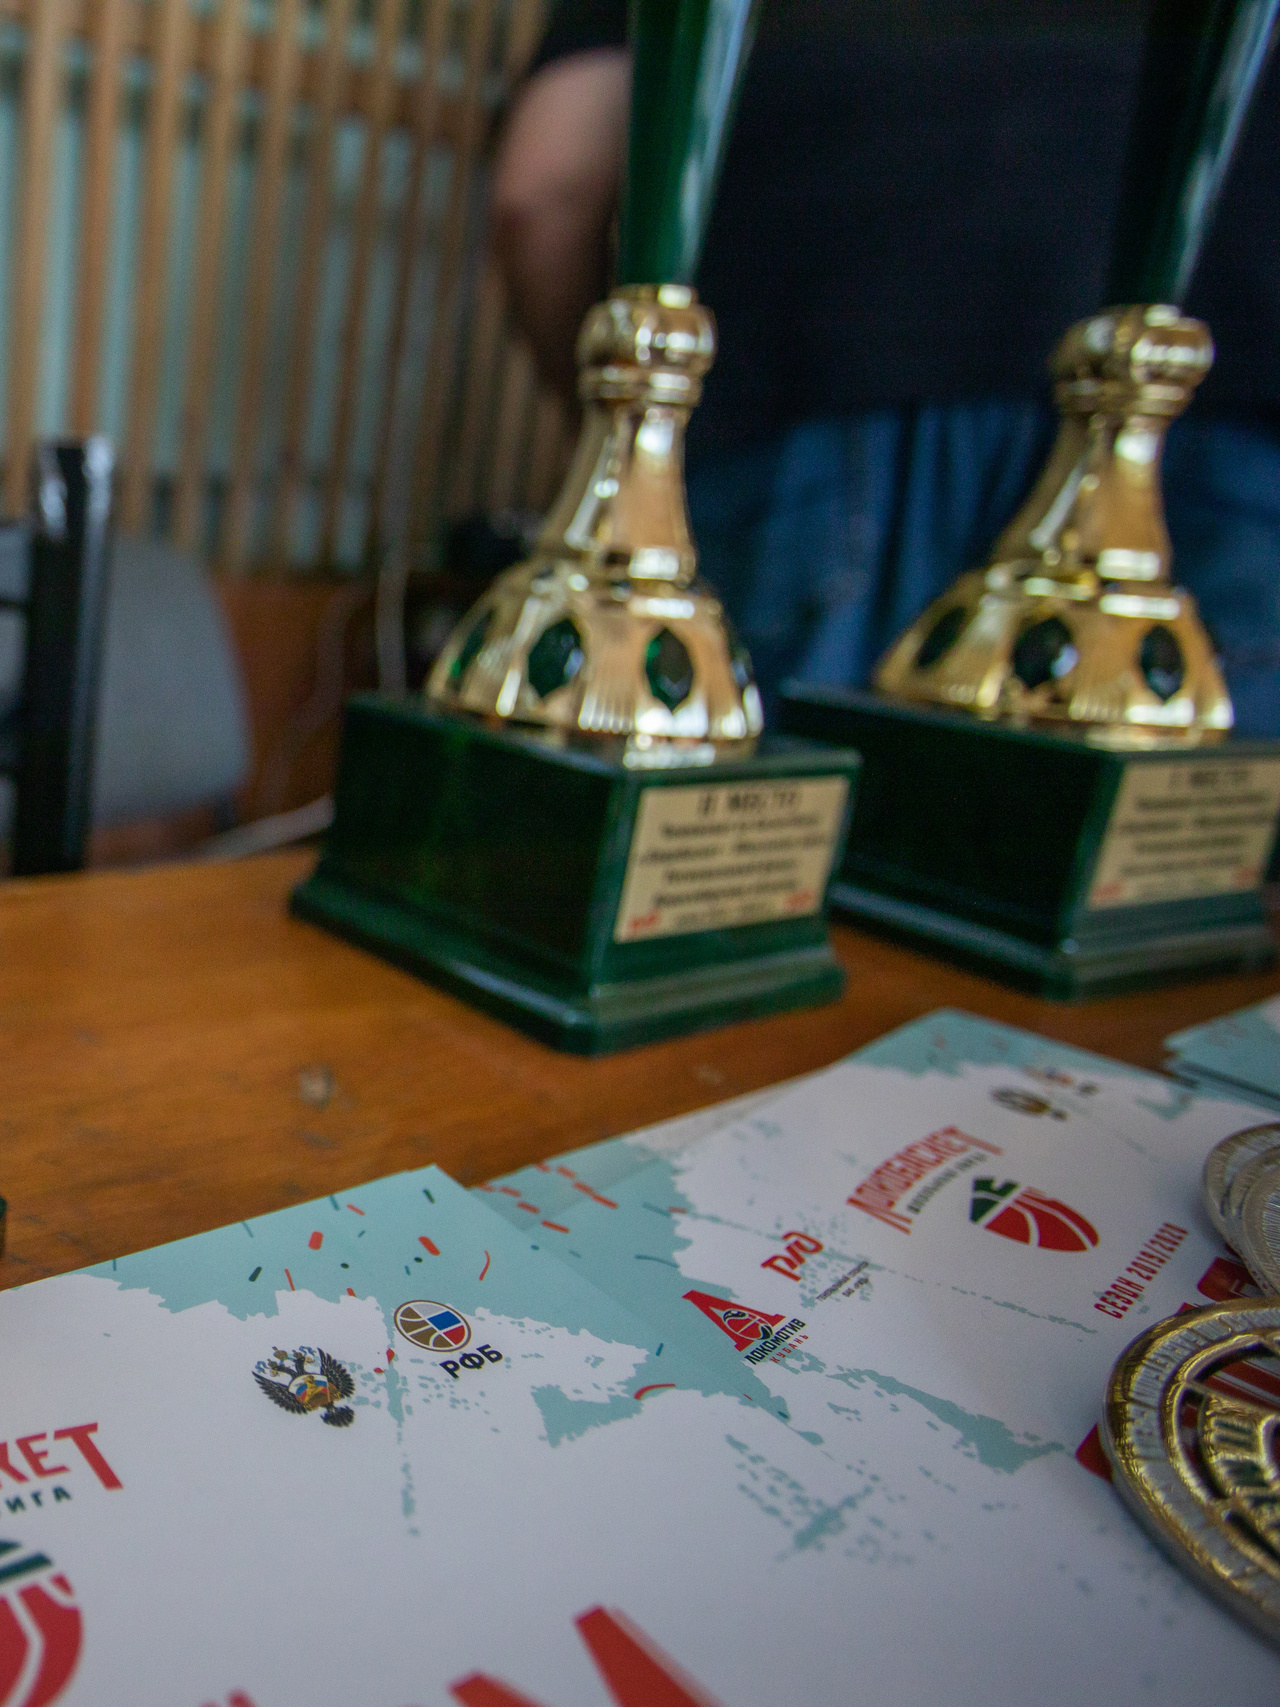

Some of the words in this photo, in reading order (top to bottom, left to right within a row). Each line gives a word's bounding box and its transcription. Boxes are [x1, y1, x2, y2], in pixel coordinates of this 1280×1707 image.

[1093, 1276, 1145, 1319] СЕЗОН
[439, 1343, 504, 1380] РФБ
[744, 1317, 807, 1366] ЛОКОМОТИВ
[769, 1333, 810, 1364] КУБАНЬ
